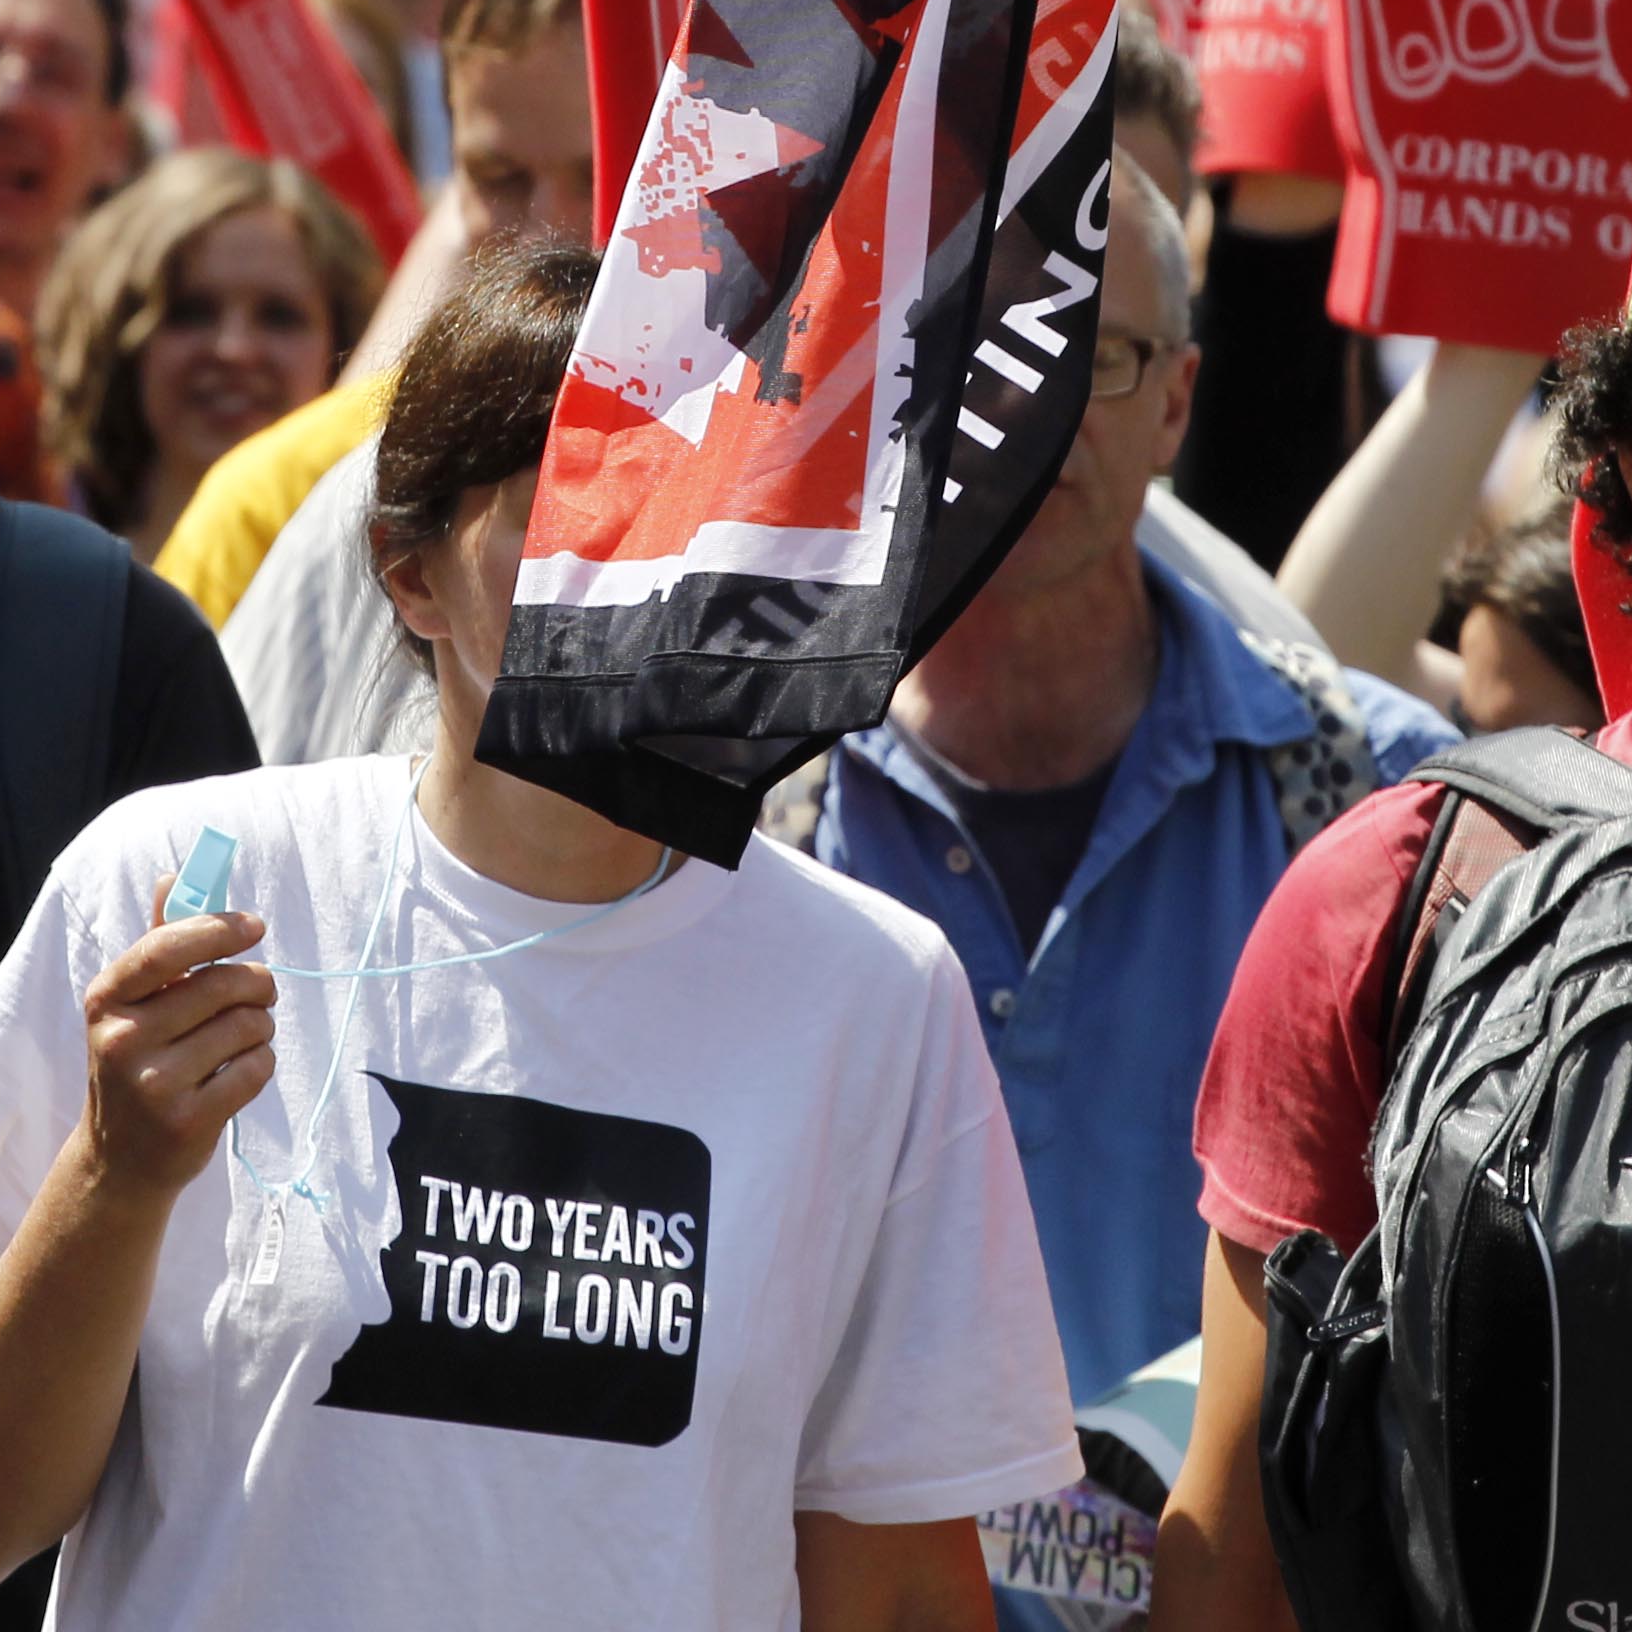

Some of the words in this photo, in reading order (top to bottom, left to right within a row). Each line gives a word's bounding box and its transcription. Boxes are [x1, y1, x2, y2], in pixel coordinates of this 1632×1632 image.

[1397, 189, 1572, 247] HANDS
[419, 1173, 536, 1253] TWO
[543, 1197, 697, 1270] YEARS
[414, 1249, 523, 1334] TOO
[541, 1269, 695, 1357] LONG
[1006, 1540, 1142, 1604] CLAIM
